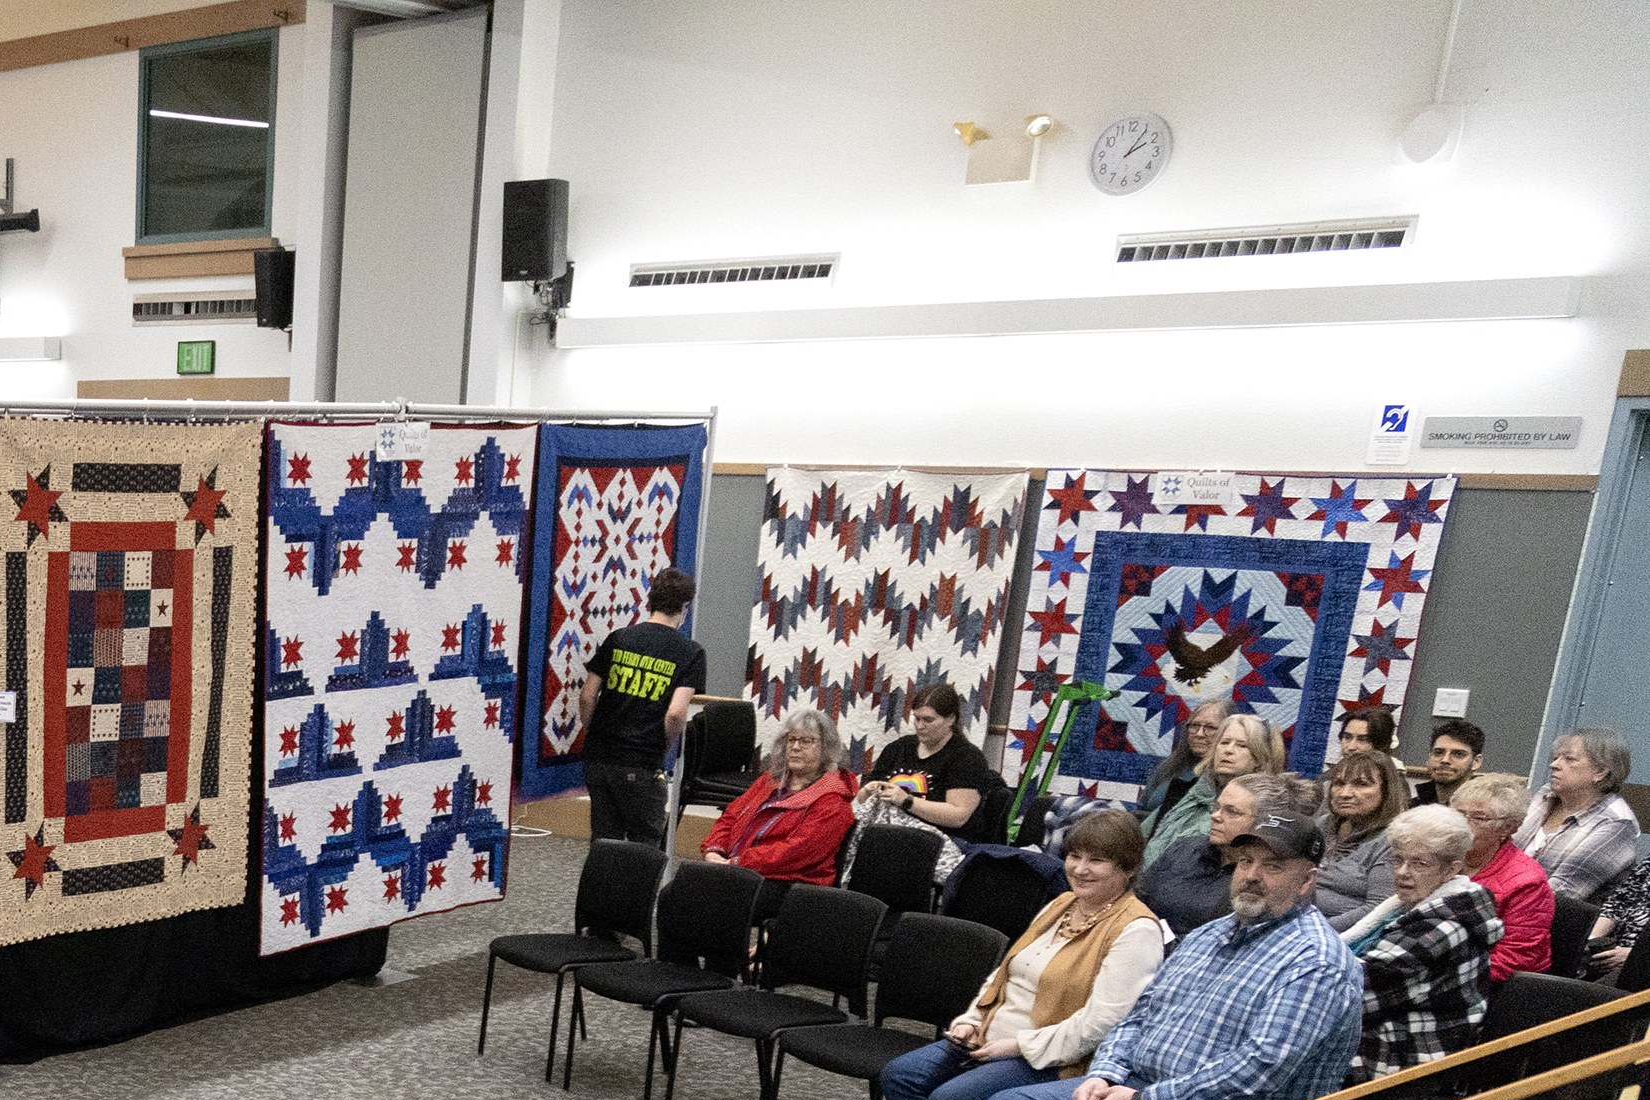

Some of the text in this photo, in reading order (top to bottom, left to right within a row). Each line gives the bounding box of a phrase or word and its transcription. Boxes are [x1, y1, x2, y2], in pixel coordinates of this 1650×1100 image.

[1116, 126, 1125, 137] 11
[1128, 121, 1139, 132] 12
[1106, 136, 1116, 148] 10
[1151, 132, 1159, 144] 2
[1098, 150, 1106, 162] 9
[1151, 146, 1160, 158] 3
[1099, 163, 1107, 175] 8
[1145, 160, 1152, 171] 4
[1109, 172, 1117, 184] 7
[1120, 175, 1128, 187] 6
[1134, 171, 1142, 183] 5
[183, 344, 209, 371] EXIT
[1428, 432, 1572, 441] SMOKING PROHIBITED BY LAW
[1187, 477, 1231, 488] Quilts of
[1193, 490, 1221, 500] Valor
[607, 664, 672, 701] STAFF
